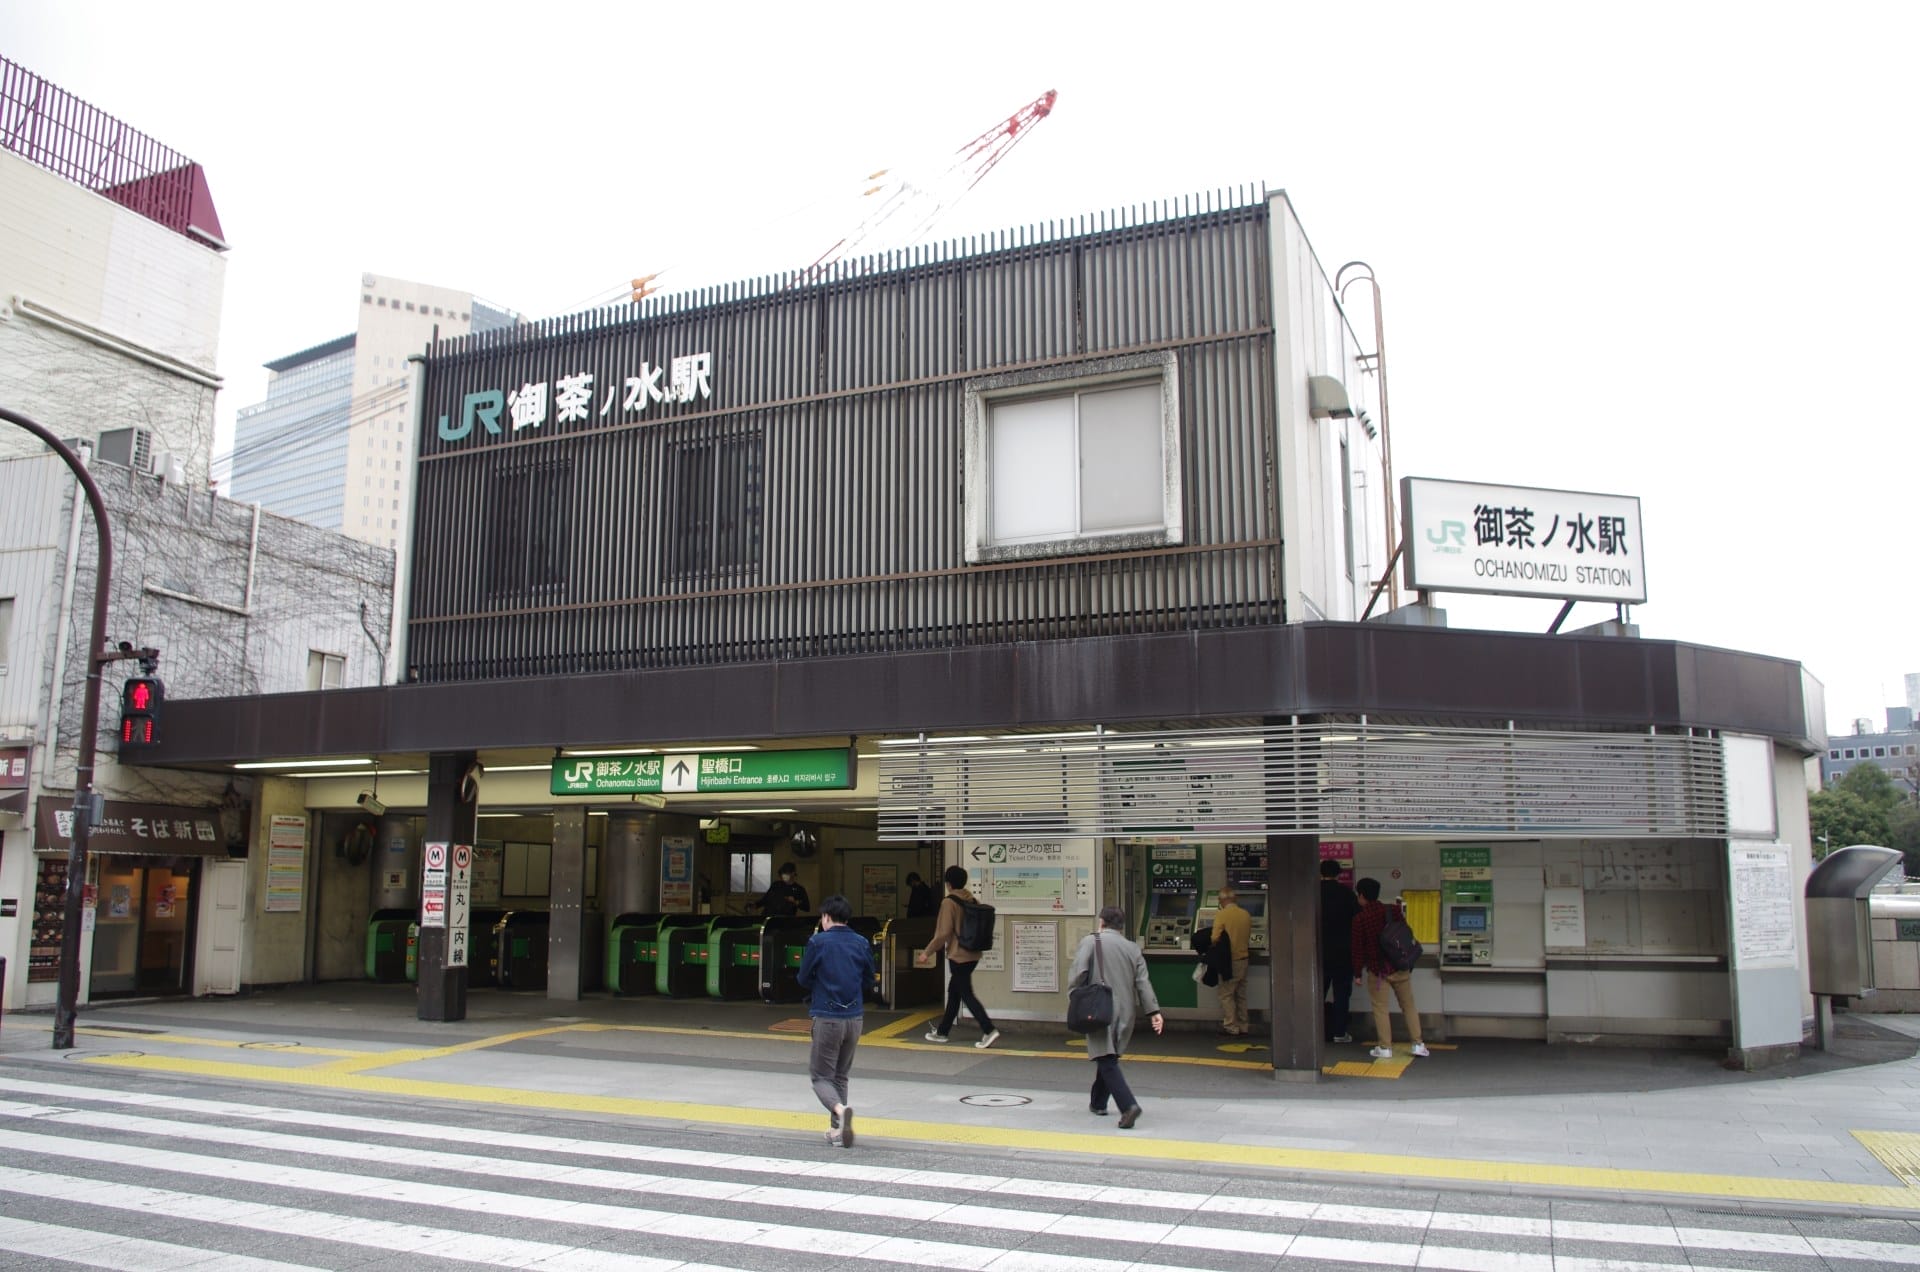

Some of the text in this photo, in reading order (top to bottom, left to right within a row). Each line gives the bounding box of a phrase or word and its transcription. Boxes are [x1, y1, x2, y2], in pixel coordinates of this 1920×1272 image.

[507, 352, 711, 431] 御茶ノ水駅
[438, 388, 504, 441] JR
[1427, 519, 1467, 546] JR
[1473, 503, 1628, 556] 御茶ノ水駅
[1474, 558, 1632, 587] OCHANOMIZU STATION
[564, 762, 594, 782] JR
[596, 760, 661, 777] 御茶ノ水駅
[701, 758, 743, 775] 聖橋口
[596, 777, 660, 788] Ochanomizu Station
[701, 774, 763, 787] Hijiribashi Entrance
[1008, 843, 1062, 854] みどりの窓口
[453, 892, 466, 963] 丸ノ内線
[1475, 950, 1489, 959] JR
